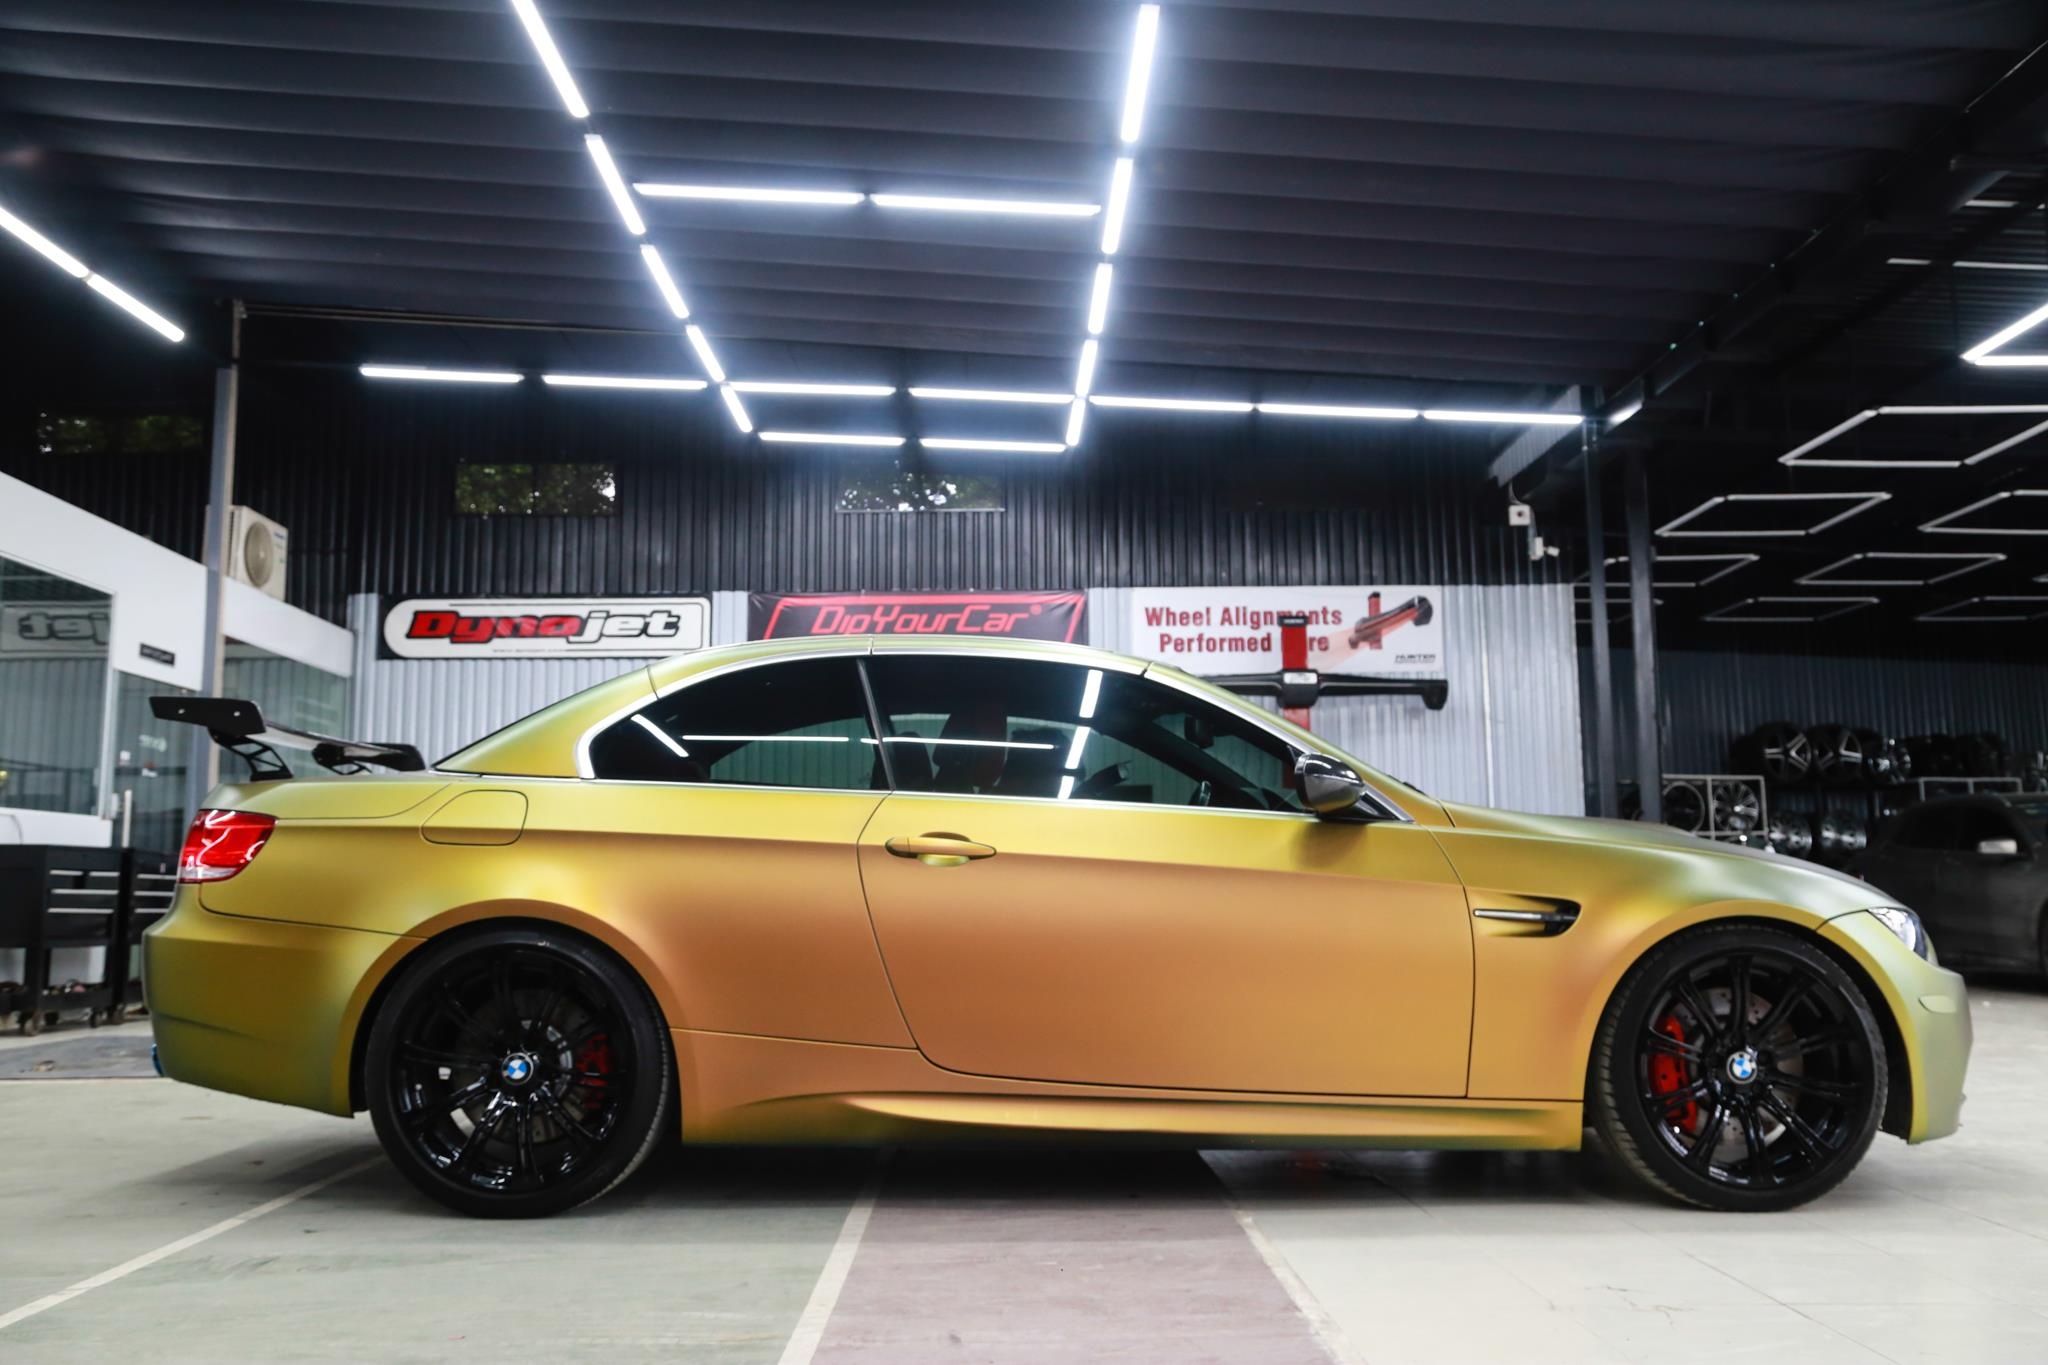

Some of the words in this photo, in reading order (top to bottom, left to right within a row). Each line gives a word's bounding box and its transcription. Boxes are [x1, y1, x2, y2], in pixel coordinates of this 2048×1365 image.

[406, 610, 681, 644] Dynojet
[1145, 606, 1212, 627] Wheel
[1159, 632, 1273, 652] Performed
